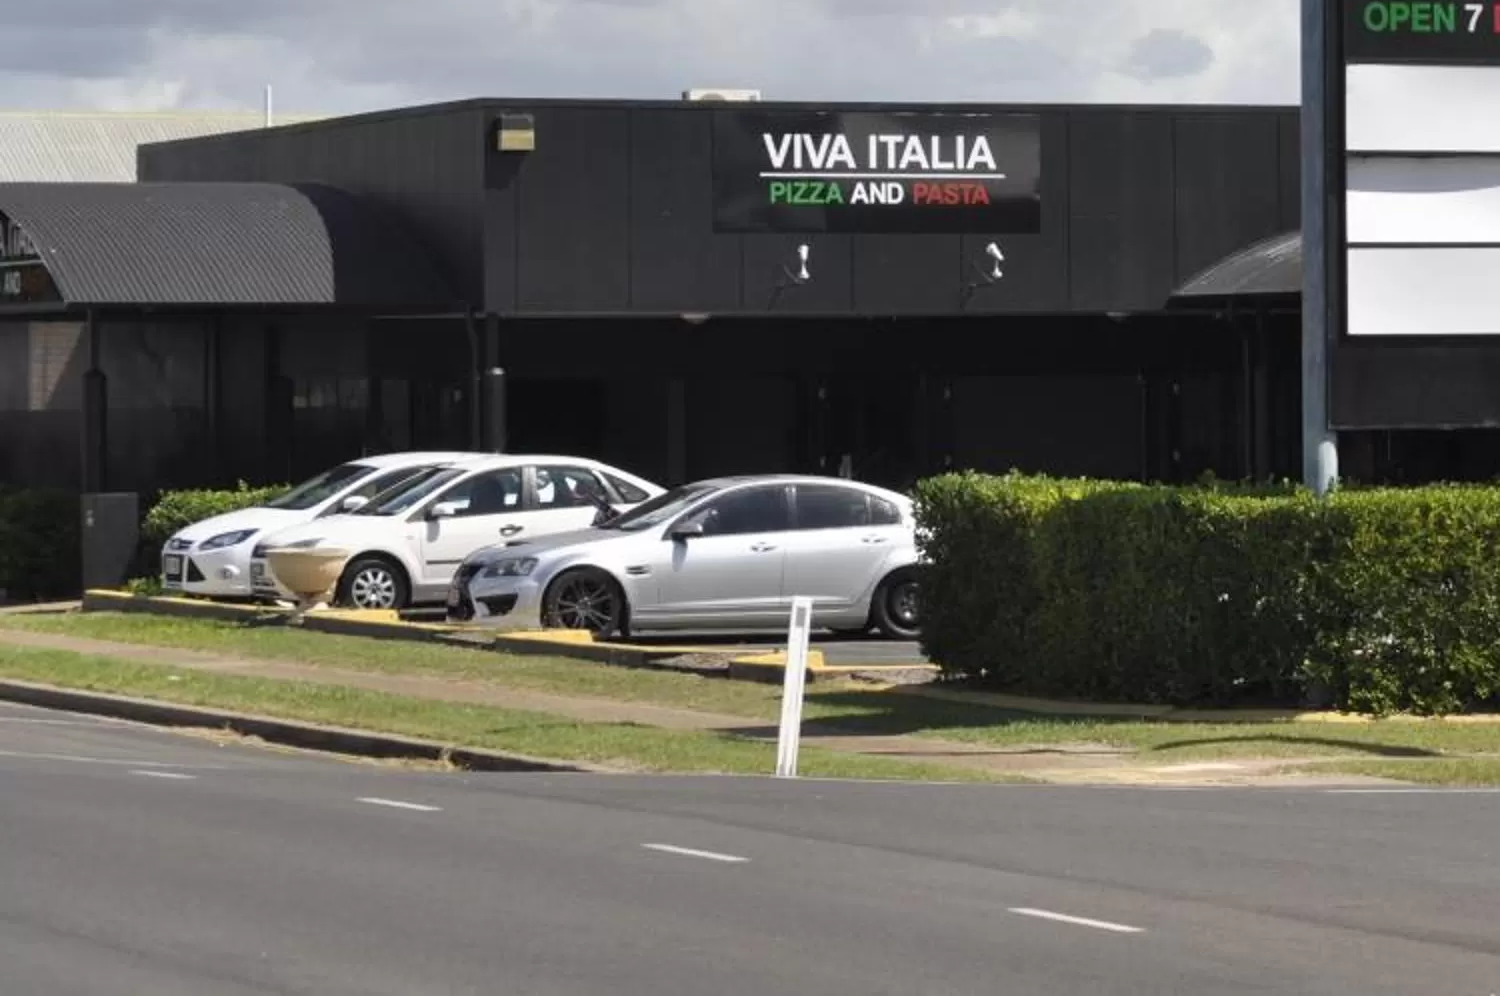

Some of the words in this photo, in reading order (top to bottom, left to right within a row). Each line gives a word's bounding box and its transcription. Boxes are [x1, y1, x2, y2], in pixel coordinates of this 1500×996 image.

[1363, 2, 1456, 32] OPEN
[1464, 3, 1484, 33] 7
[763, 133, 857, 169] VIVA
[868, 135, 997, 170] ITALIA
[770, 182, 843, 204] PIZZA
[851, 182, 904, 204] AND
[912, 183, 989, 204] PASTA
